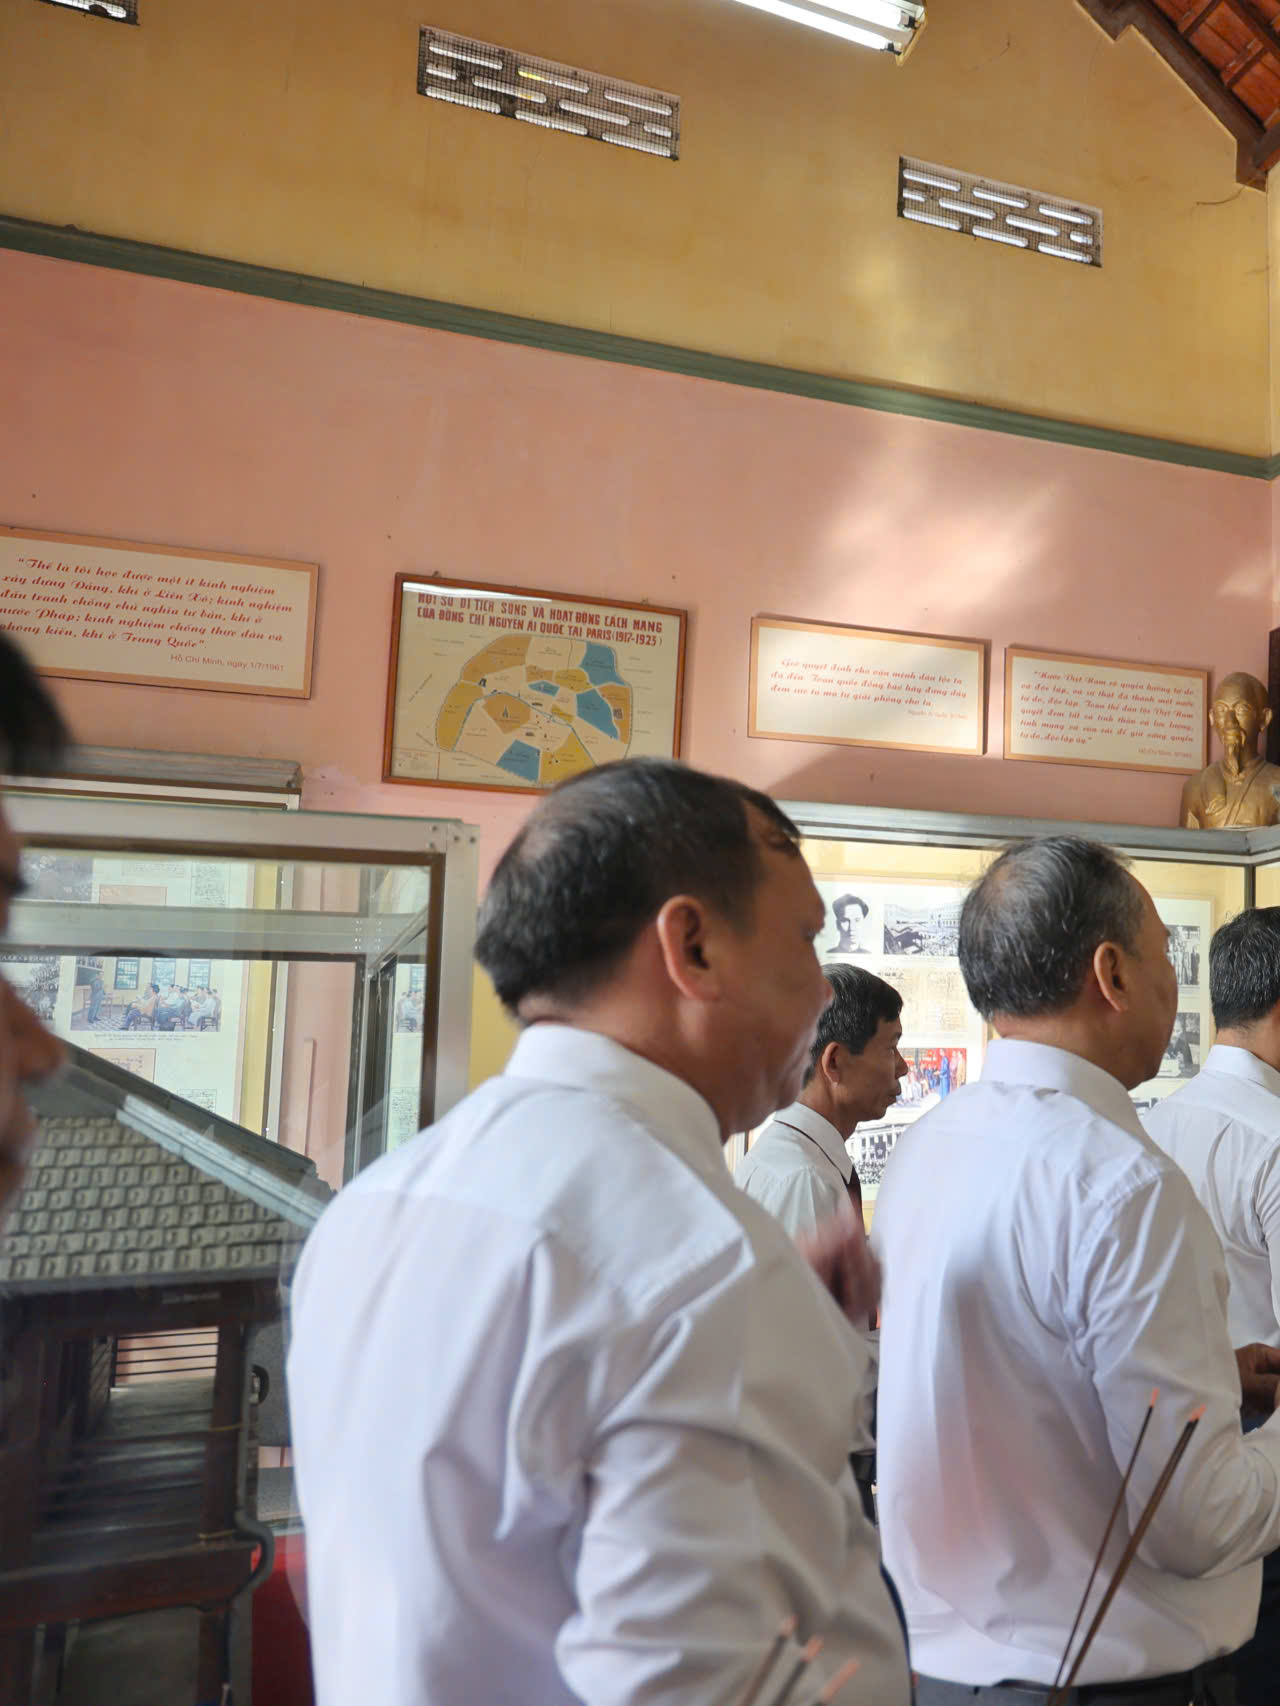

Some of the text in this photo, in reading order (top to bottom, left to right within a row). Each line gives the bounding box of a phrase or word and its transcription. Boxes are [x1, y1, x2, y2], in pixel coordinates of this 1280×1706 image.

[199, 578, 227, 590] kinh
[118, 585, 139, 596] khi
[217, 595, 245, 608] kinh
[31, 593, 68, 604] tranh
[230, 612, 251, 624] khi
[85, 612, 114, 625] kinh
[81, 628, 103, 641] khi
[586, 626, 612, 641] PARIS
